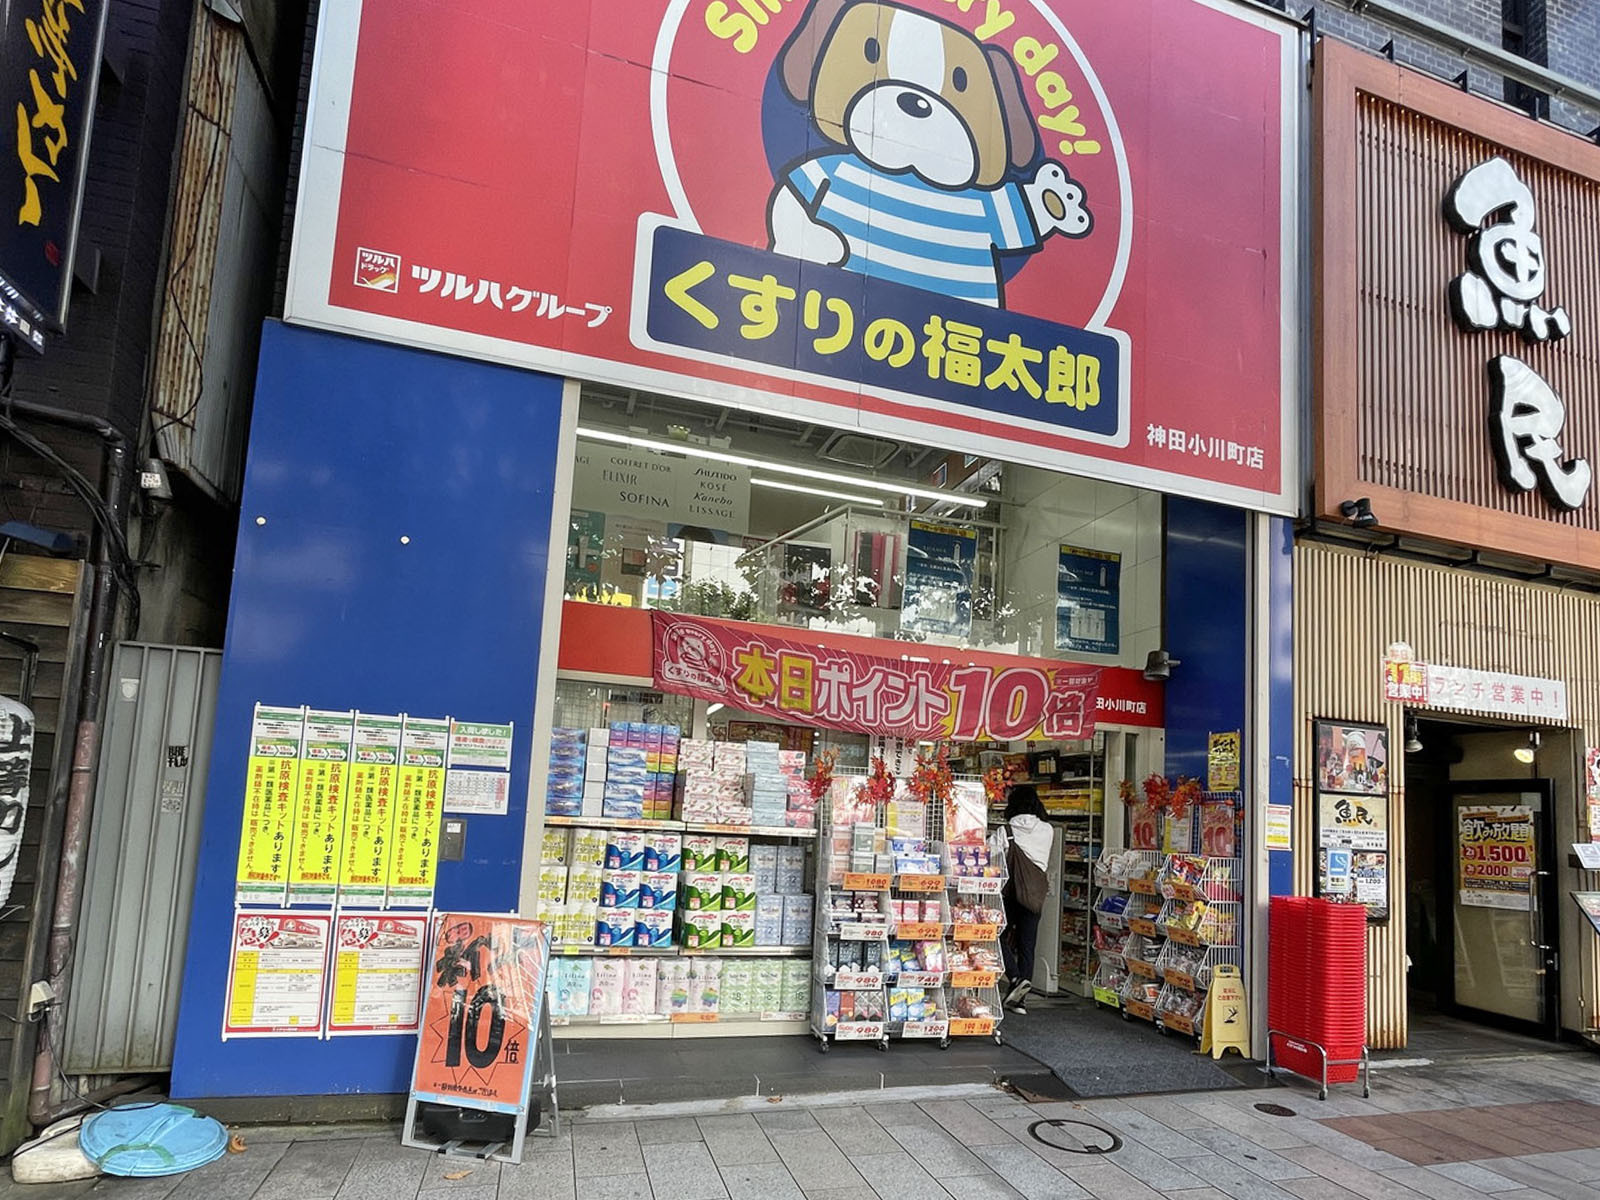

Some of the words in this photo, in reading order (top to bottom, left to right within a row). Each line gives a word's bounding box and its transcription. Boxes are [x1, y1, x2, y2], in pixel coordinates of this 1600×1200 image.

[360, 262, 389, 274] ドラッグ
[361, 251, 396, 268] ツルハ
[411, 264, 613, 328] ツルハグループ
[664, 259, 1103, 411] くすりの福太郎
[1146, 423, 1266, 471] 神田小川町店
[603, 470, 638, 486] ELIXIR
[619, 491, 670, 508] SOFINA
[693, 492, 734, 506] Kanebo
[689, 505, 735, 519] LISSAGE
[1463, 819, 1530, 841] 飲み放題
